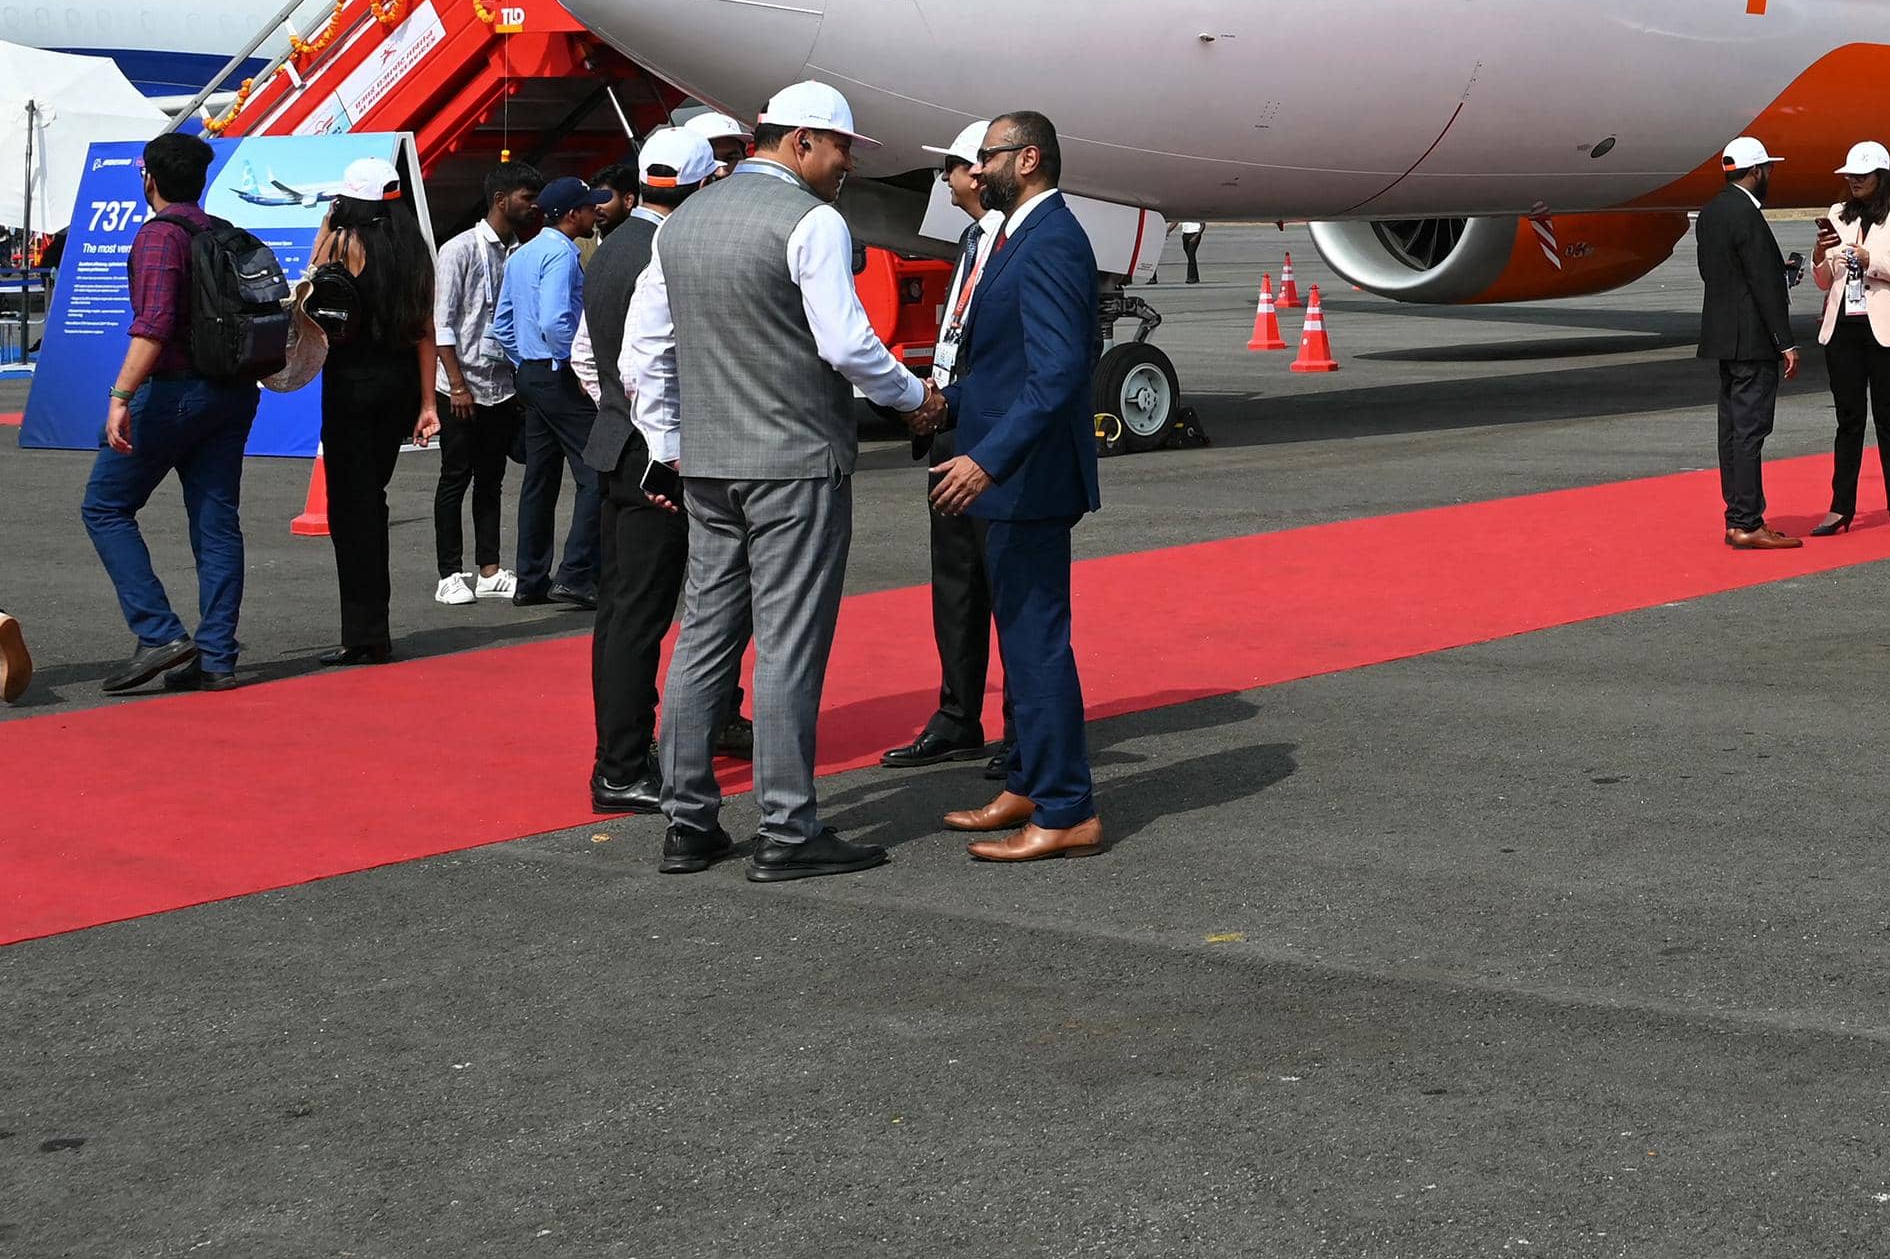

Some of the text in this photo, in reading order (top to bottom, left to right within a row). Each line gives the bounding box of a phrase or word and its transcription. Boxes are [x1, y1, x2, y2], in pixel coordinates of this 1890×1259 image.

[501, 7, 525, 25] TLD
[83, 243, 97, 254] The
[97, 243, 117, 254] most
